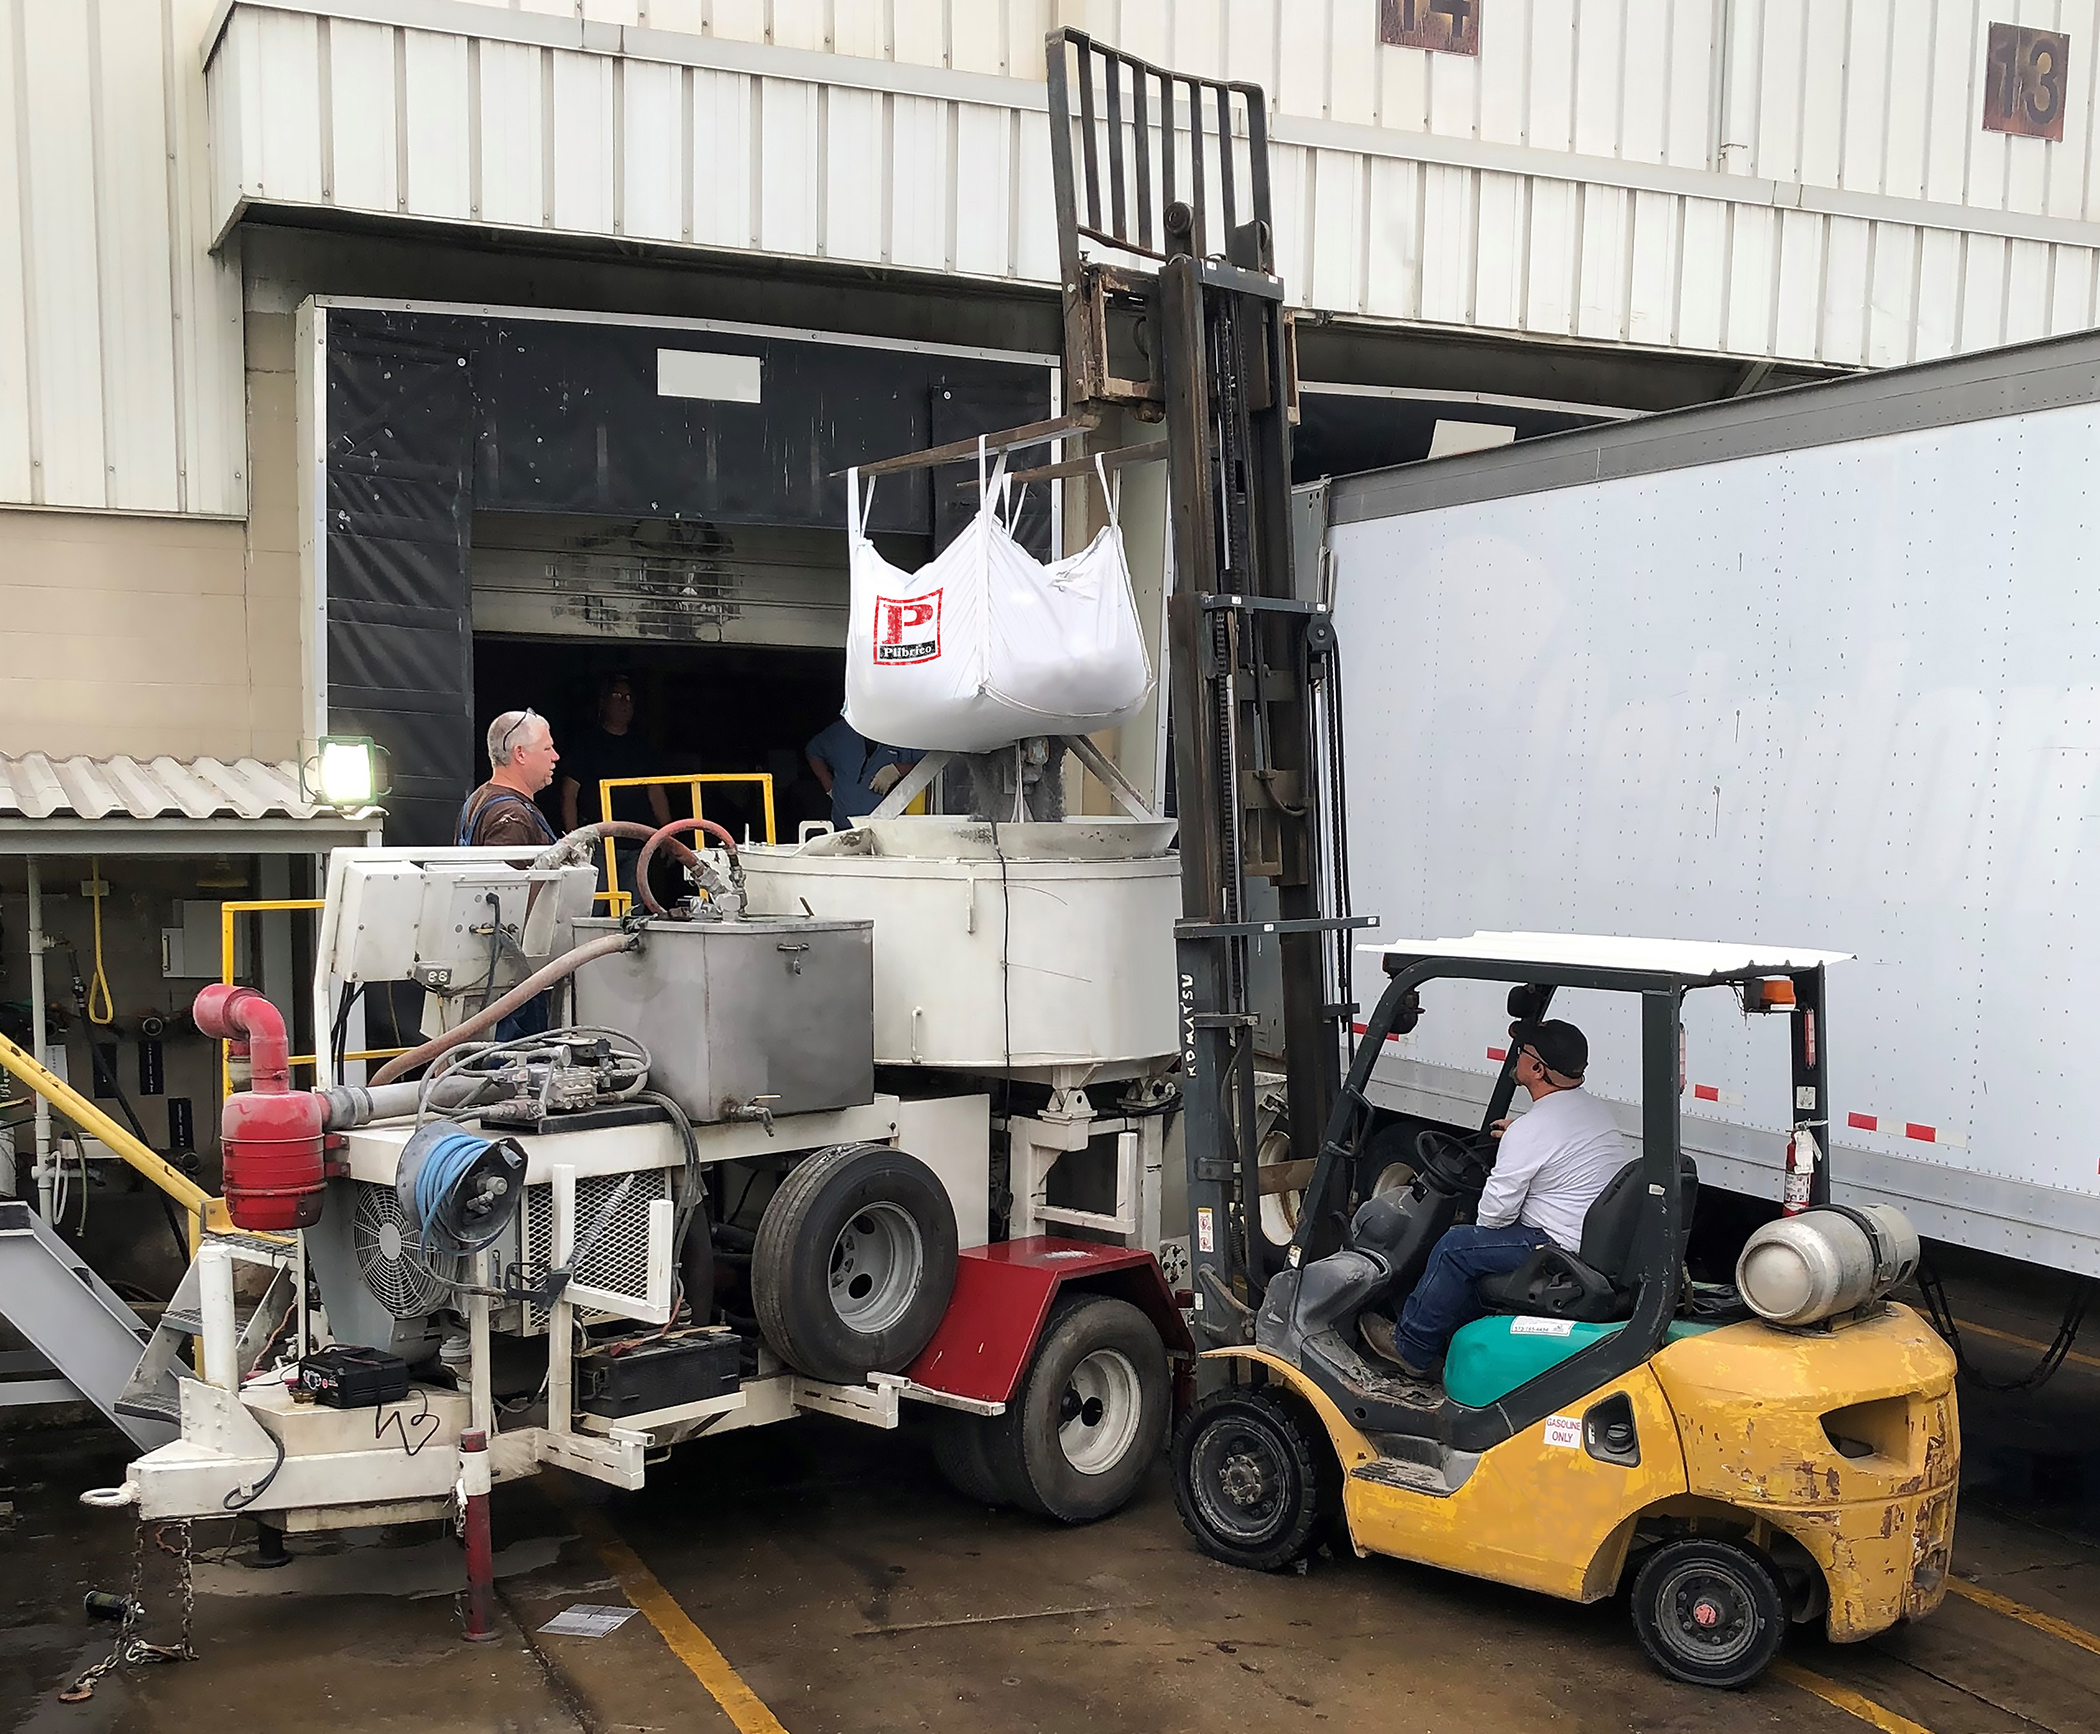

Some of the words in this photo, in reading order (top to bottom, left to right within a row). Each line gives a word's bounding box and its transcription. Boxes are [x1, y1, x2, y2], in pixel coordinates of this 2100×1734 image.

[1995, 39, 2058, 124] 13
[882, 603, 933, 644] P
[883, 645, 932, 657] Plibrico
[1180, 973, 1196, 1076] KOMATSU
[1546, 1417, 1581, 1431] GASOLINE
[1552, 1431, 1574, 1443] ONLY
